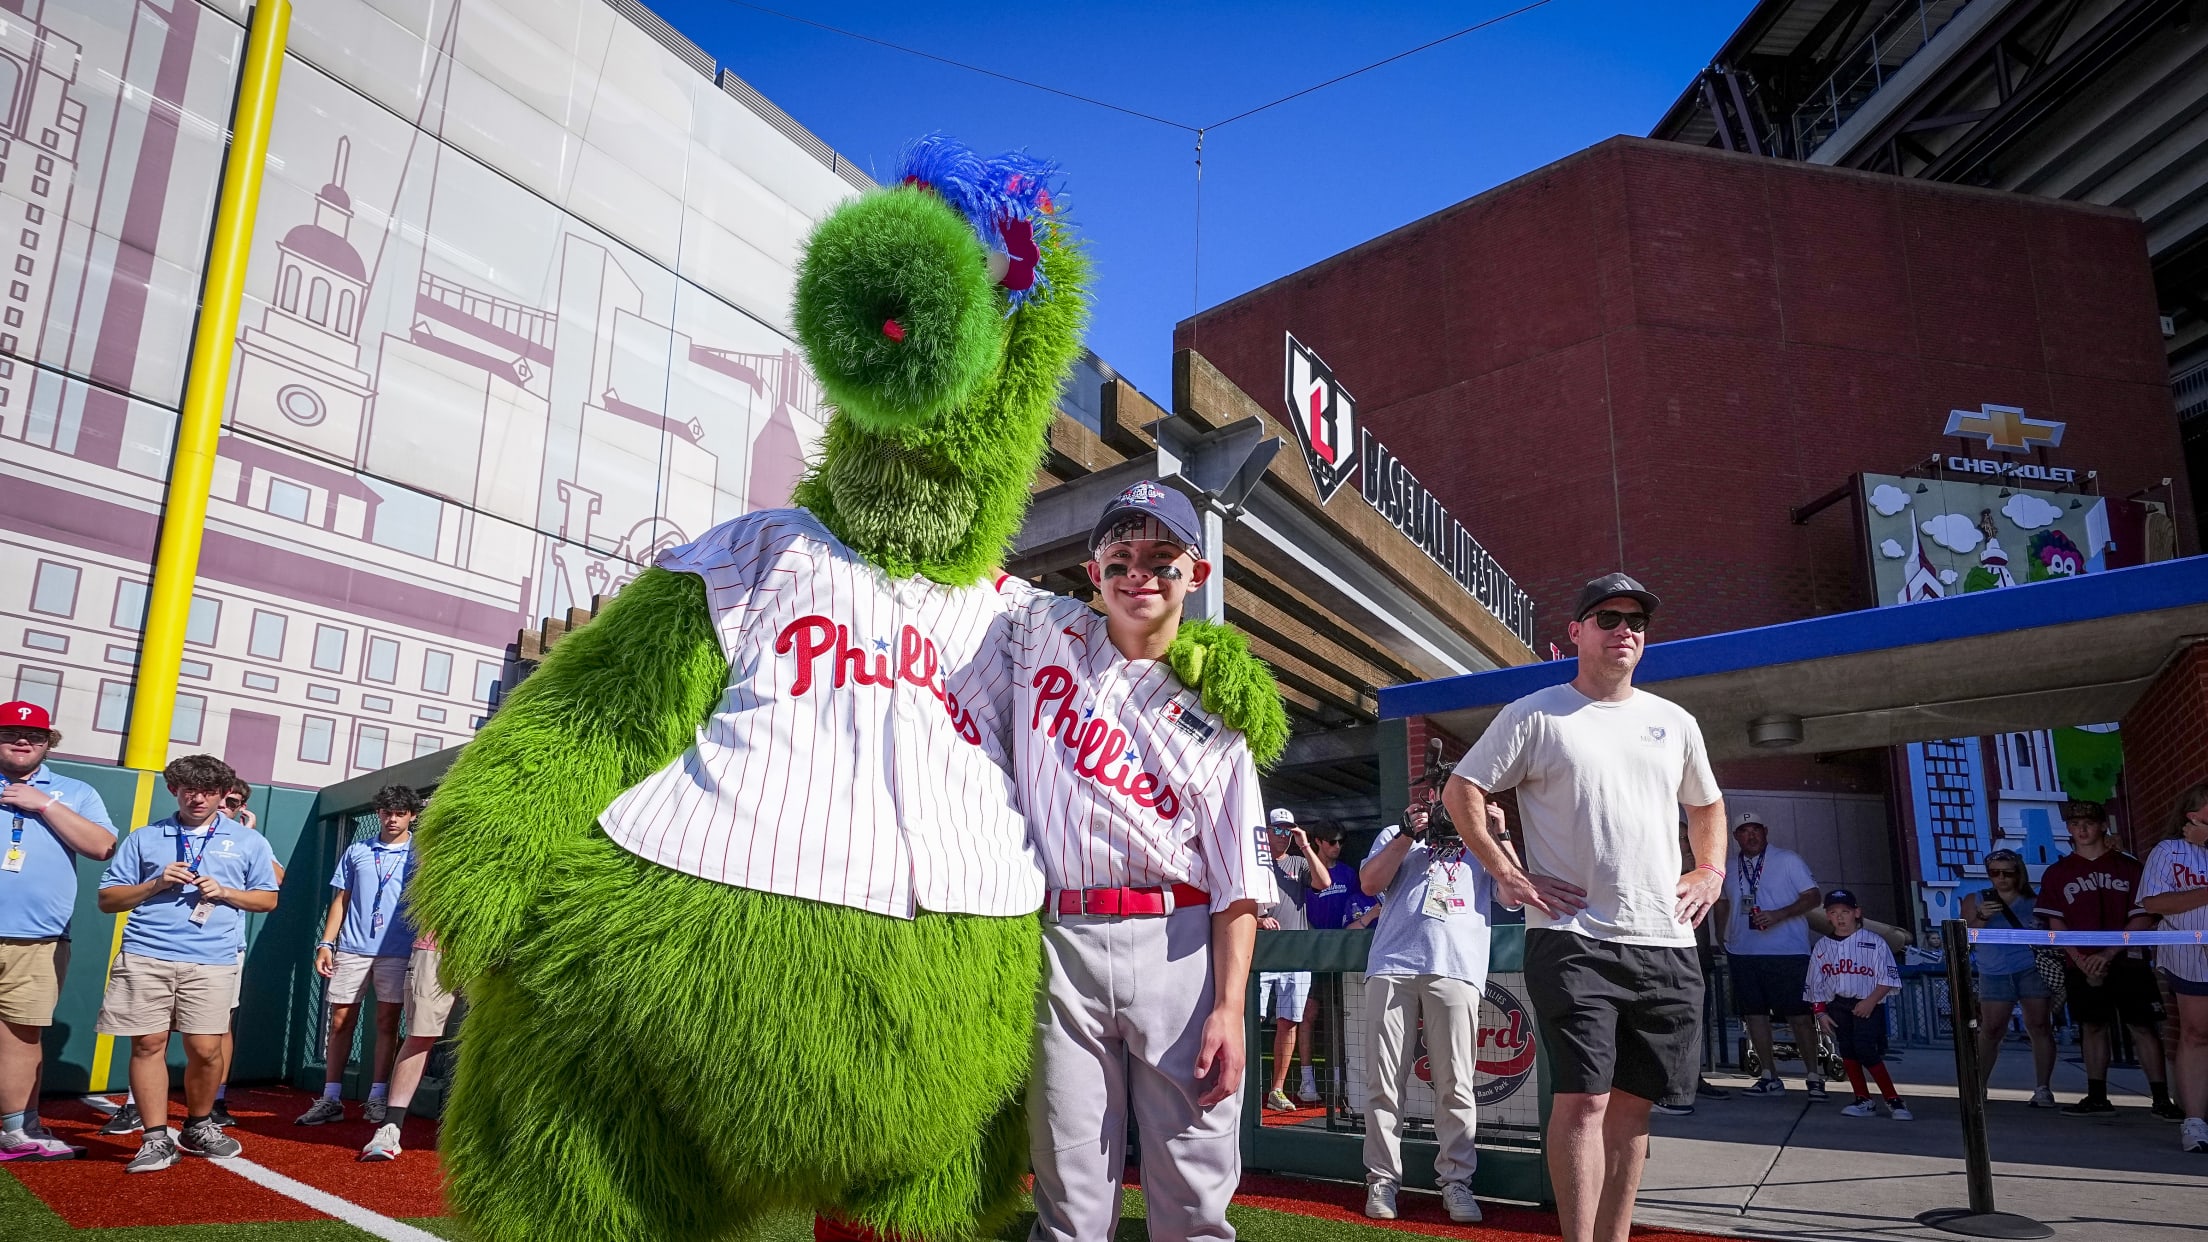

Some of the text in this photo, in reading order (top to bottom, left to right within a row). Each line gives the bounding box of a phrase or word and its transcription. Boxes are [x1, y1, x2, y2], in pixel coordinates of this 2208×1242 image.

[1947, 456, 2077, 483] CHEVROLET
[1361, 426, 1454, 577] BASEBALL
[1453, 518, 1520, 638] LIFESTYLE
[774, 614, 982, 746] Phillies
[17, 707, 32, 721] P
[1031, 664, 1180, 821] Phillies
[1743, 813, 1751, 821] P
[1476, 1009, 1525, 1049] rd
[1477, 1080, 1510, 1098] Bank Park
